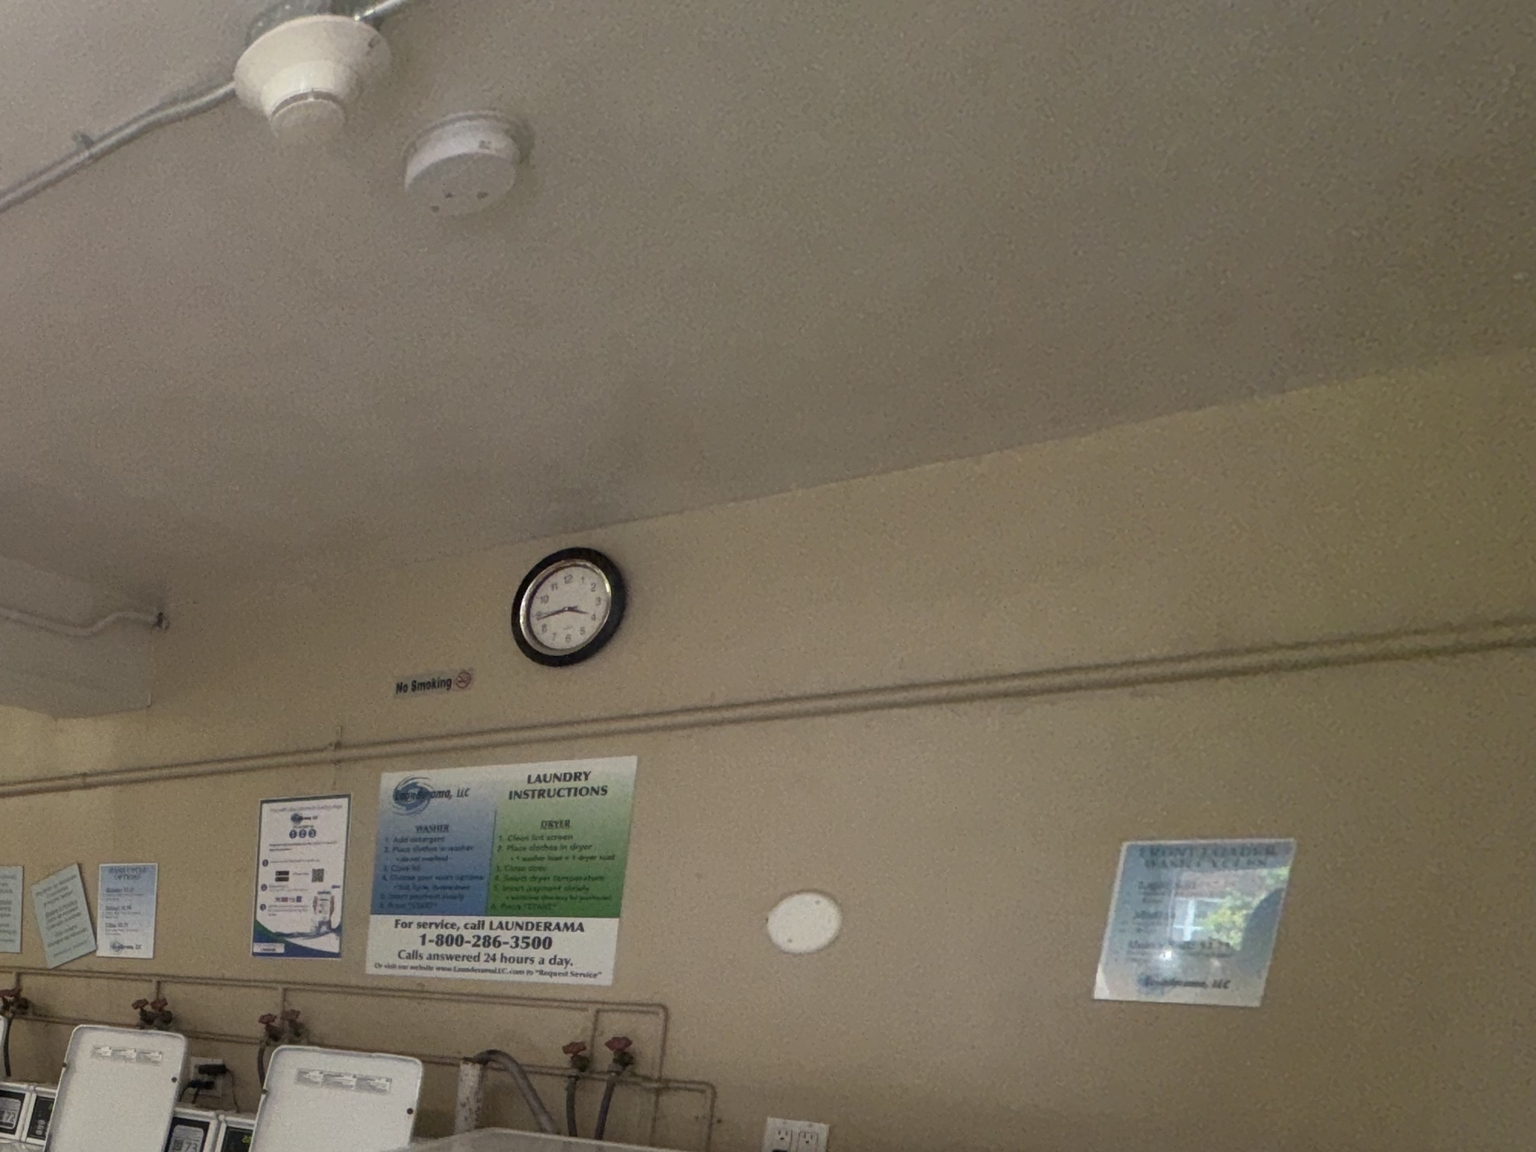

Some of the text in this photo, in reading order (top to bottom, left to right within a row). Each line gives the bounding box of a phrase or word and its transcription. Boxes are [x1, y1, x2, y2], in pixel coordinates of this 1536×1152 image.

[564, 574, 573, 584] 12
[581, 576, 585, 584] 1
[551, 583, 558, 591] 11
[590, 582, 596, 592] 2
[540, 595, 549, 604] 10
[595, 597, 601, 606] 3
[591, 613, 596, 621] 4
[541, 624, 547, 633] 8
[580, 626, 585, 635] 5
[552, 633, 557, 641] 7
[565, 634, 571, 642] 6
[395, 677, 452, 694] No Smoking
[527, 771, 591, 784] LAUNDRY
[457, 788, 470, 797] LLC
[508, 785, 608, 800] INSTRUCTIONS
[415, 825, 449, 833] WASHER
[540, 820, 571, 829] DRYER
[508, 834, 529, 842] Clean
[569, 843, 593, 852] dryer
[394, 919, 585, 933] For service, call LAUNDERAMA
[419, 933, 553, 950] 1-800-286-3500
[397, 949, 574, 969] Calls answered 24 hours a day.
[535, 968, 568, 978] "Request
[570, 970, 602, 978] Service"
[5, 1111, 16, 1123] 72
[185, 1141, 199, 1152] 73
